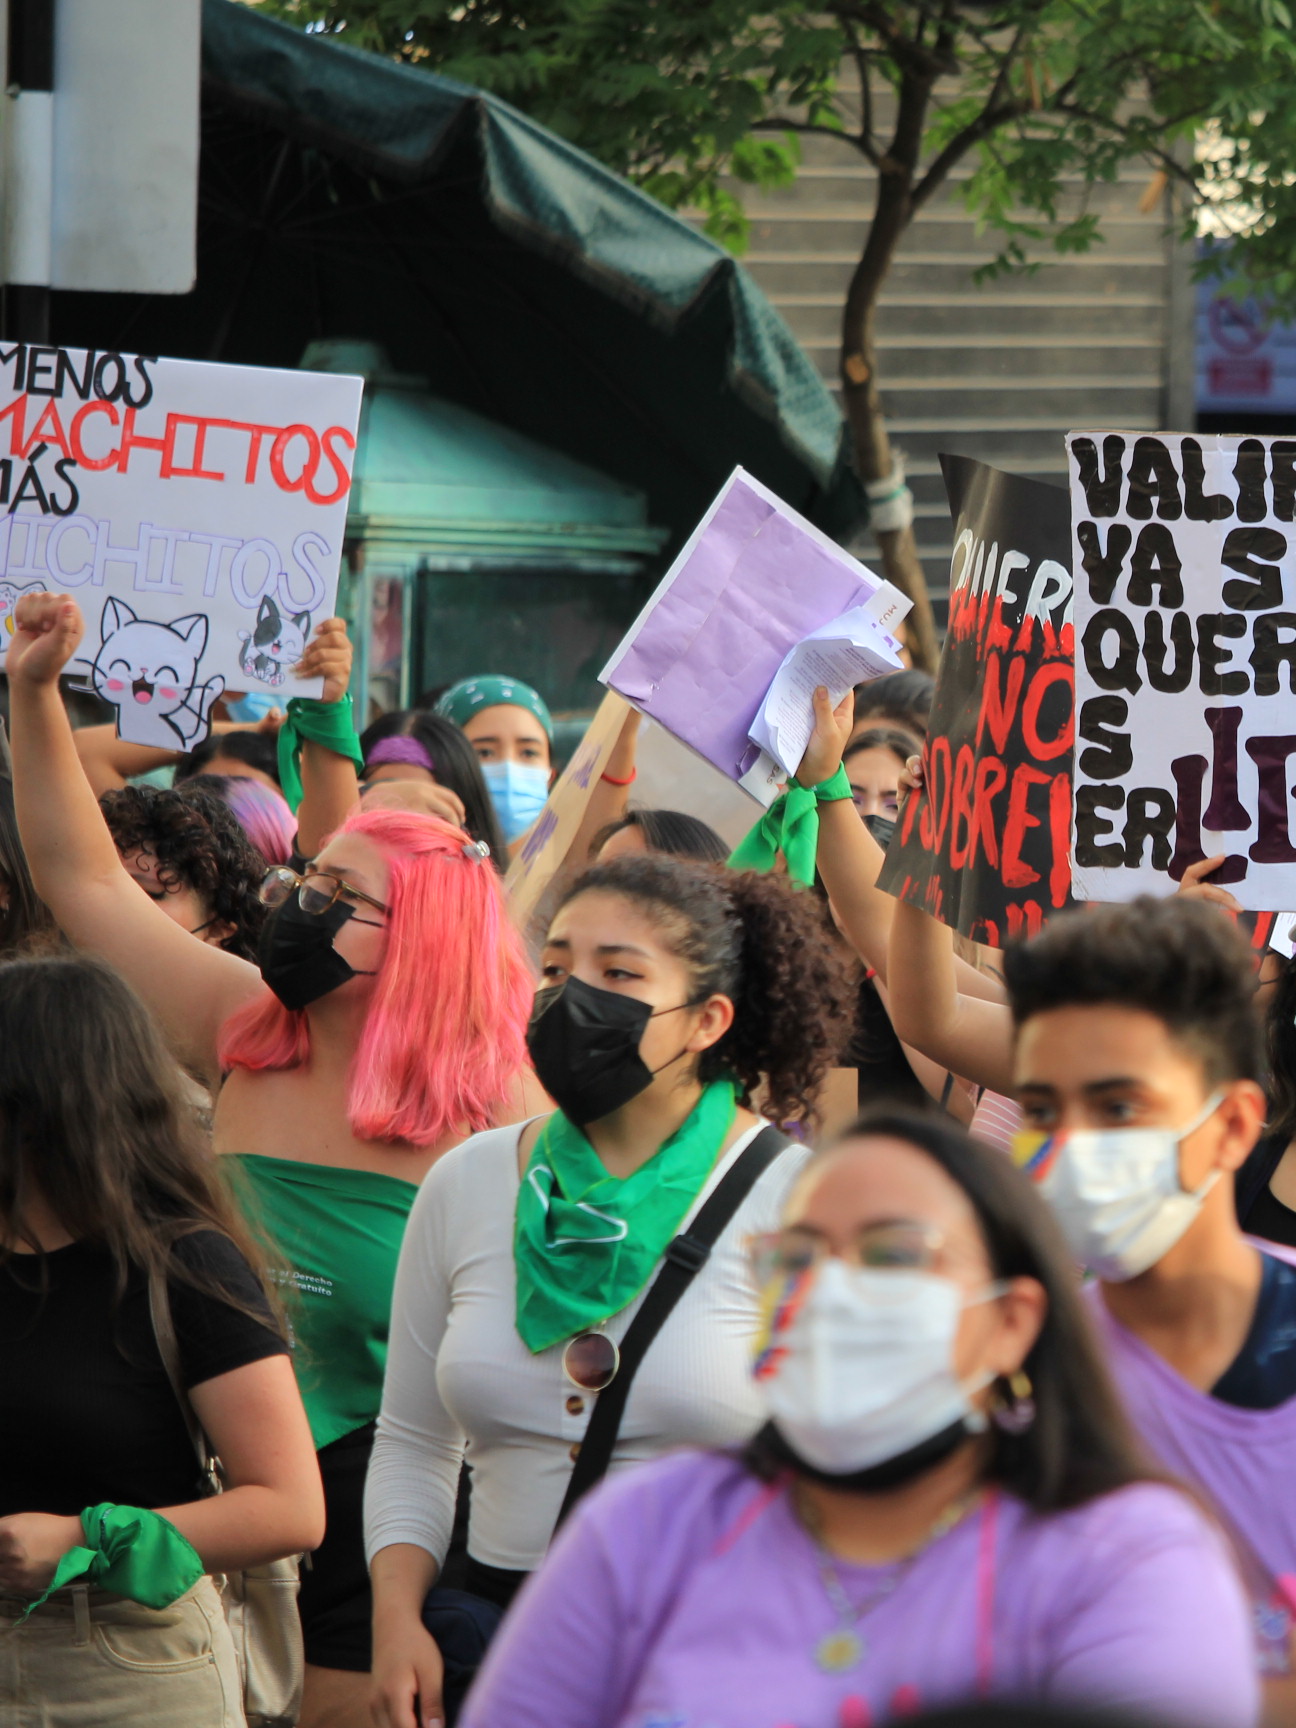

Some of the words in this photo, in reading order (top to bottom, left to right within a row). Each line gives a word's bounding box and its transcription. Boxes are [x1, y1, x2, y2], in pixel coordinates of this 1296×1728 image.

[949, 528, 1075, 652] QUIER
[975, 651, 1075, 761] NO
[292, 1271, 333, 1287] Derecho
